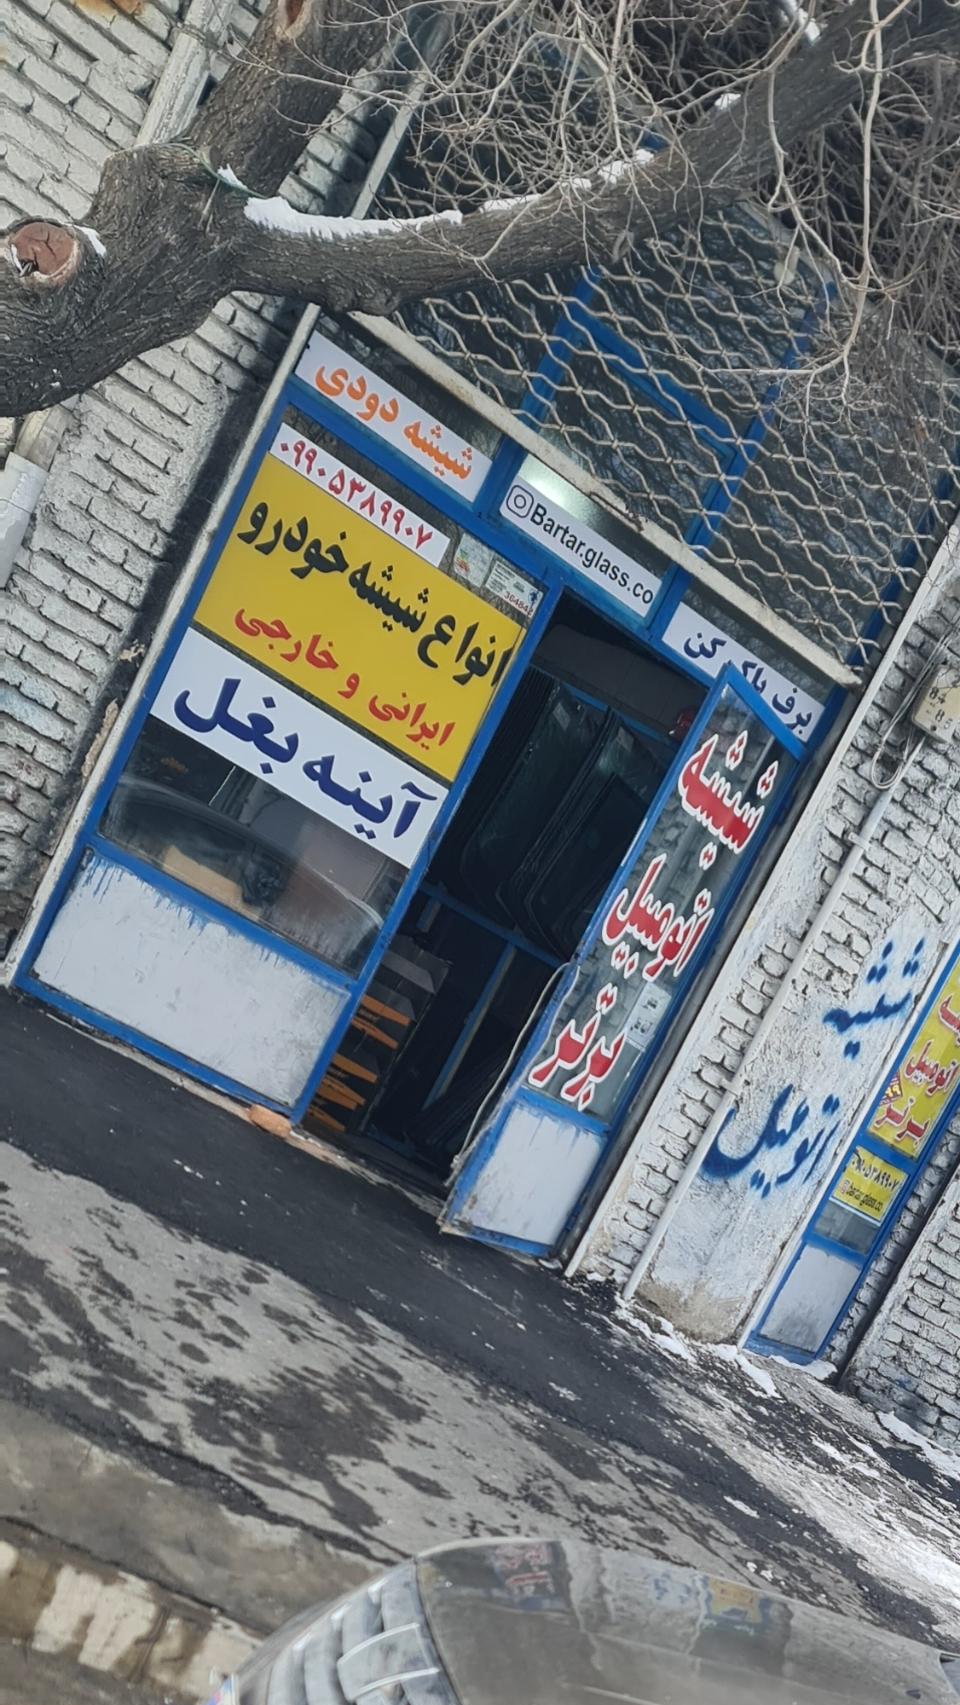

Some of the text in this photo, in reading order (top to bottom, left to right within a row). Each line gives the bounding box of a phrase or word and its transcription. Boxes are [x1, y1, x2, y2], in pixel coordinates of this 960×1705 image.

[314, 366, 473, 481] شیشه دودی
[237, 501, 349, 579] خودرو
[281, 440, 433, 550] ۰۹۹۰۵۳۸۹۹۰۷
[348, 561, 427, 633] شیشه
[530, 502, 654, 605] Bartar.glass.co
[234, 608, 456, 750] ایرانی و خارجی
[417, 614, 515, 687] انواع
[683, 632, 727, 659] کن
[174, 678, 438, 840] آینه بغل
[772, 687, 812, 735] برف
[678, 730, 779, 870] شیشه
[602, 853, 716, 981] اتومبیل
[528, 982, 628, 1111] برتر
[821, 938, 925, 1060] شیشه
[873, 1097, 931, 1148] برتر
